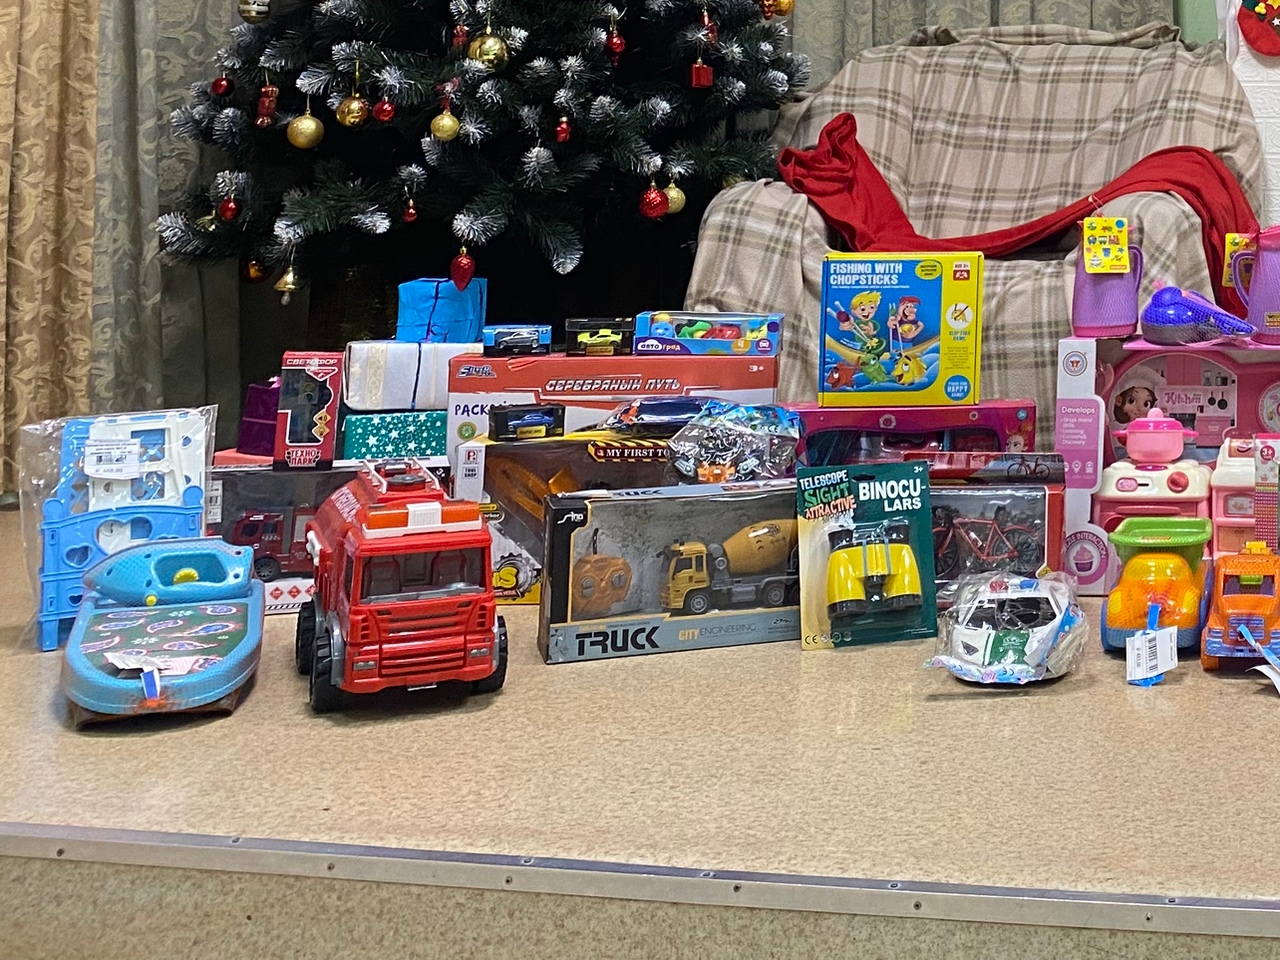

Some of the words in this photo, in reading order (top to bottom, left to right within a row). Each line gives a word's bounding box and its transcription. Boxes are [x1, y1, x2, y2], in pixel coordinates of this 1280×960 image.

[830, 263, 872, 274] FISHING
[875, 263, 903, 273] WITH
[830, 274, 899, 285] CHOPSTICKS
[645, 379, 681, 390] ПУТЬ
[1061, 406, 1095, 415] Develops
[606, 449, 622, 457] MY
[624, 449, 654, 457] FIRST
[291, 457, 314, 465] ПАРК
[914, 466, 923, 474] 3+
[799, 470, 848, 490] TELESCOPE
[804, 483, 850, 507] SIGHT
[859, 478, 926, 501] BINOCU-
[805, 495, 857, 520] ATTRACTIVE
[884, 498, 922, 512] LARS
[678, 629, 699, 641] CITY
[700, 623, 757, 636] ENGINEERING
[576, 626, 660, 656] TRUCK
[805, 634, 818, 644] CE
